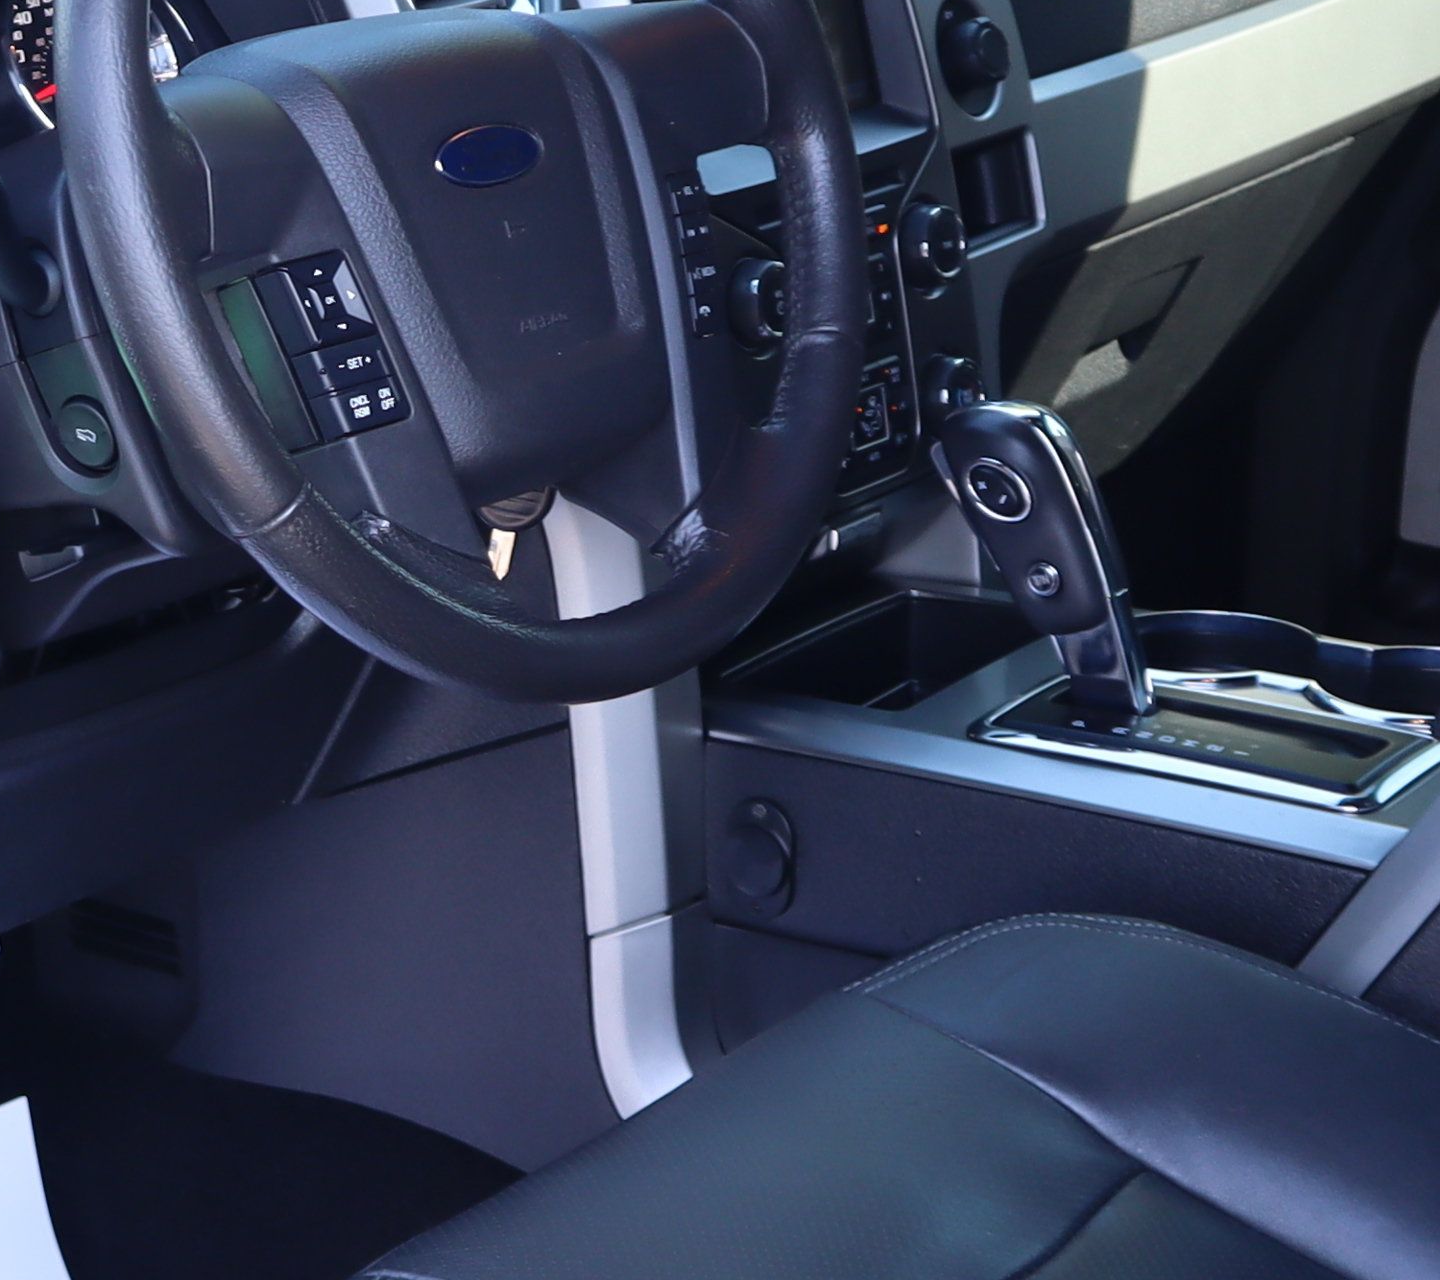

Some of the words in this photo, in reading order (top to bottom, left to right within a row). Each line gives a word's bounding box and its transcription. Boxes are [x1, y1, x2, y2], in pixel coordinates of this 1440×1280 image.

[13, 10, 32, 25] 40
[346, 356, 364, 370] SET
[378, 387, 392, 399] ON
[380, 397, 395, 411] OFF
